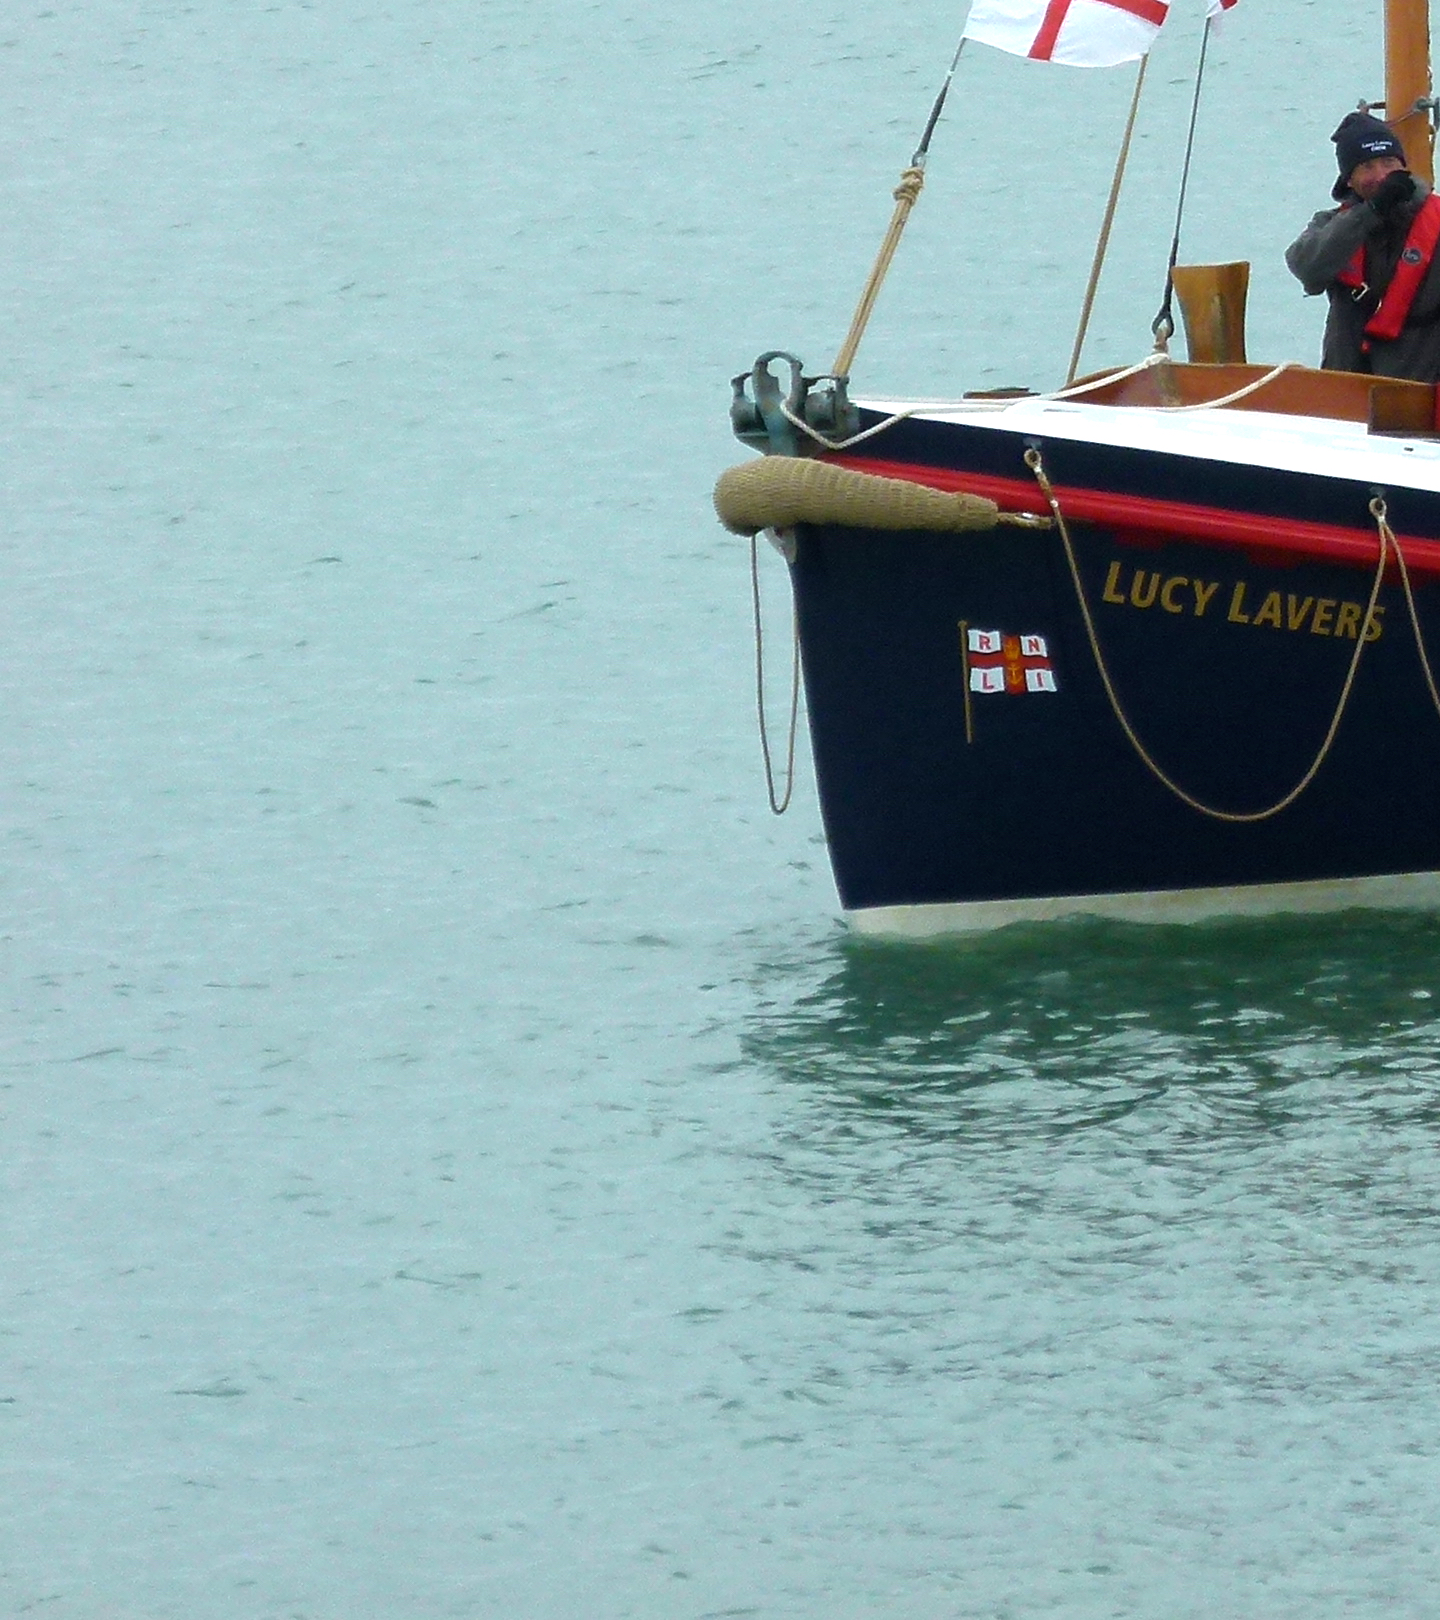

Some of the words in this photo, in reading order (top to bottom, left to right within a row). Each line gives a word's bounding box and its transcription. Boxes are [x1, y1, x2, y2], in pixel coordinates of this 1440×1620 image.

[1101, 560, 1219, 618] LUCY
[1227, 581, 1387, 643] LAVERS
[977, 634, 992, 651] R
[1028, 637, 1041, 653] N
[982, 672, 995, 690] L
